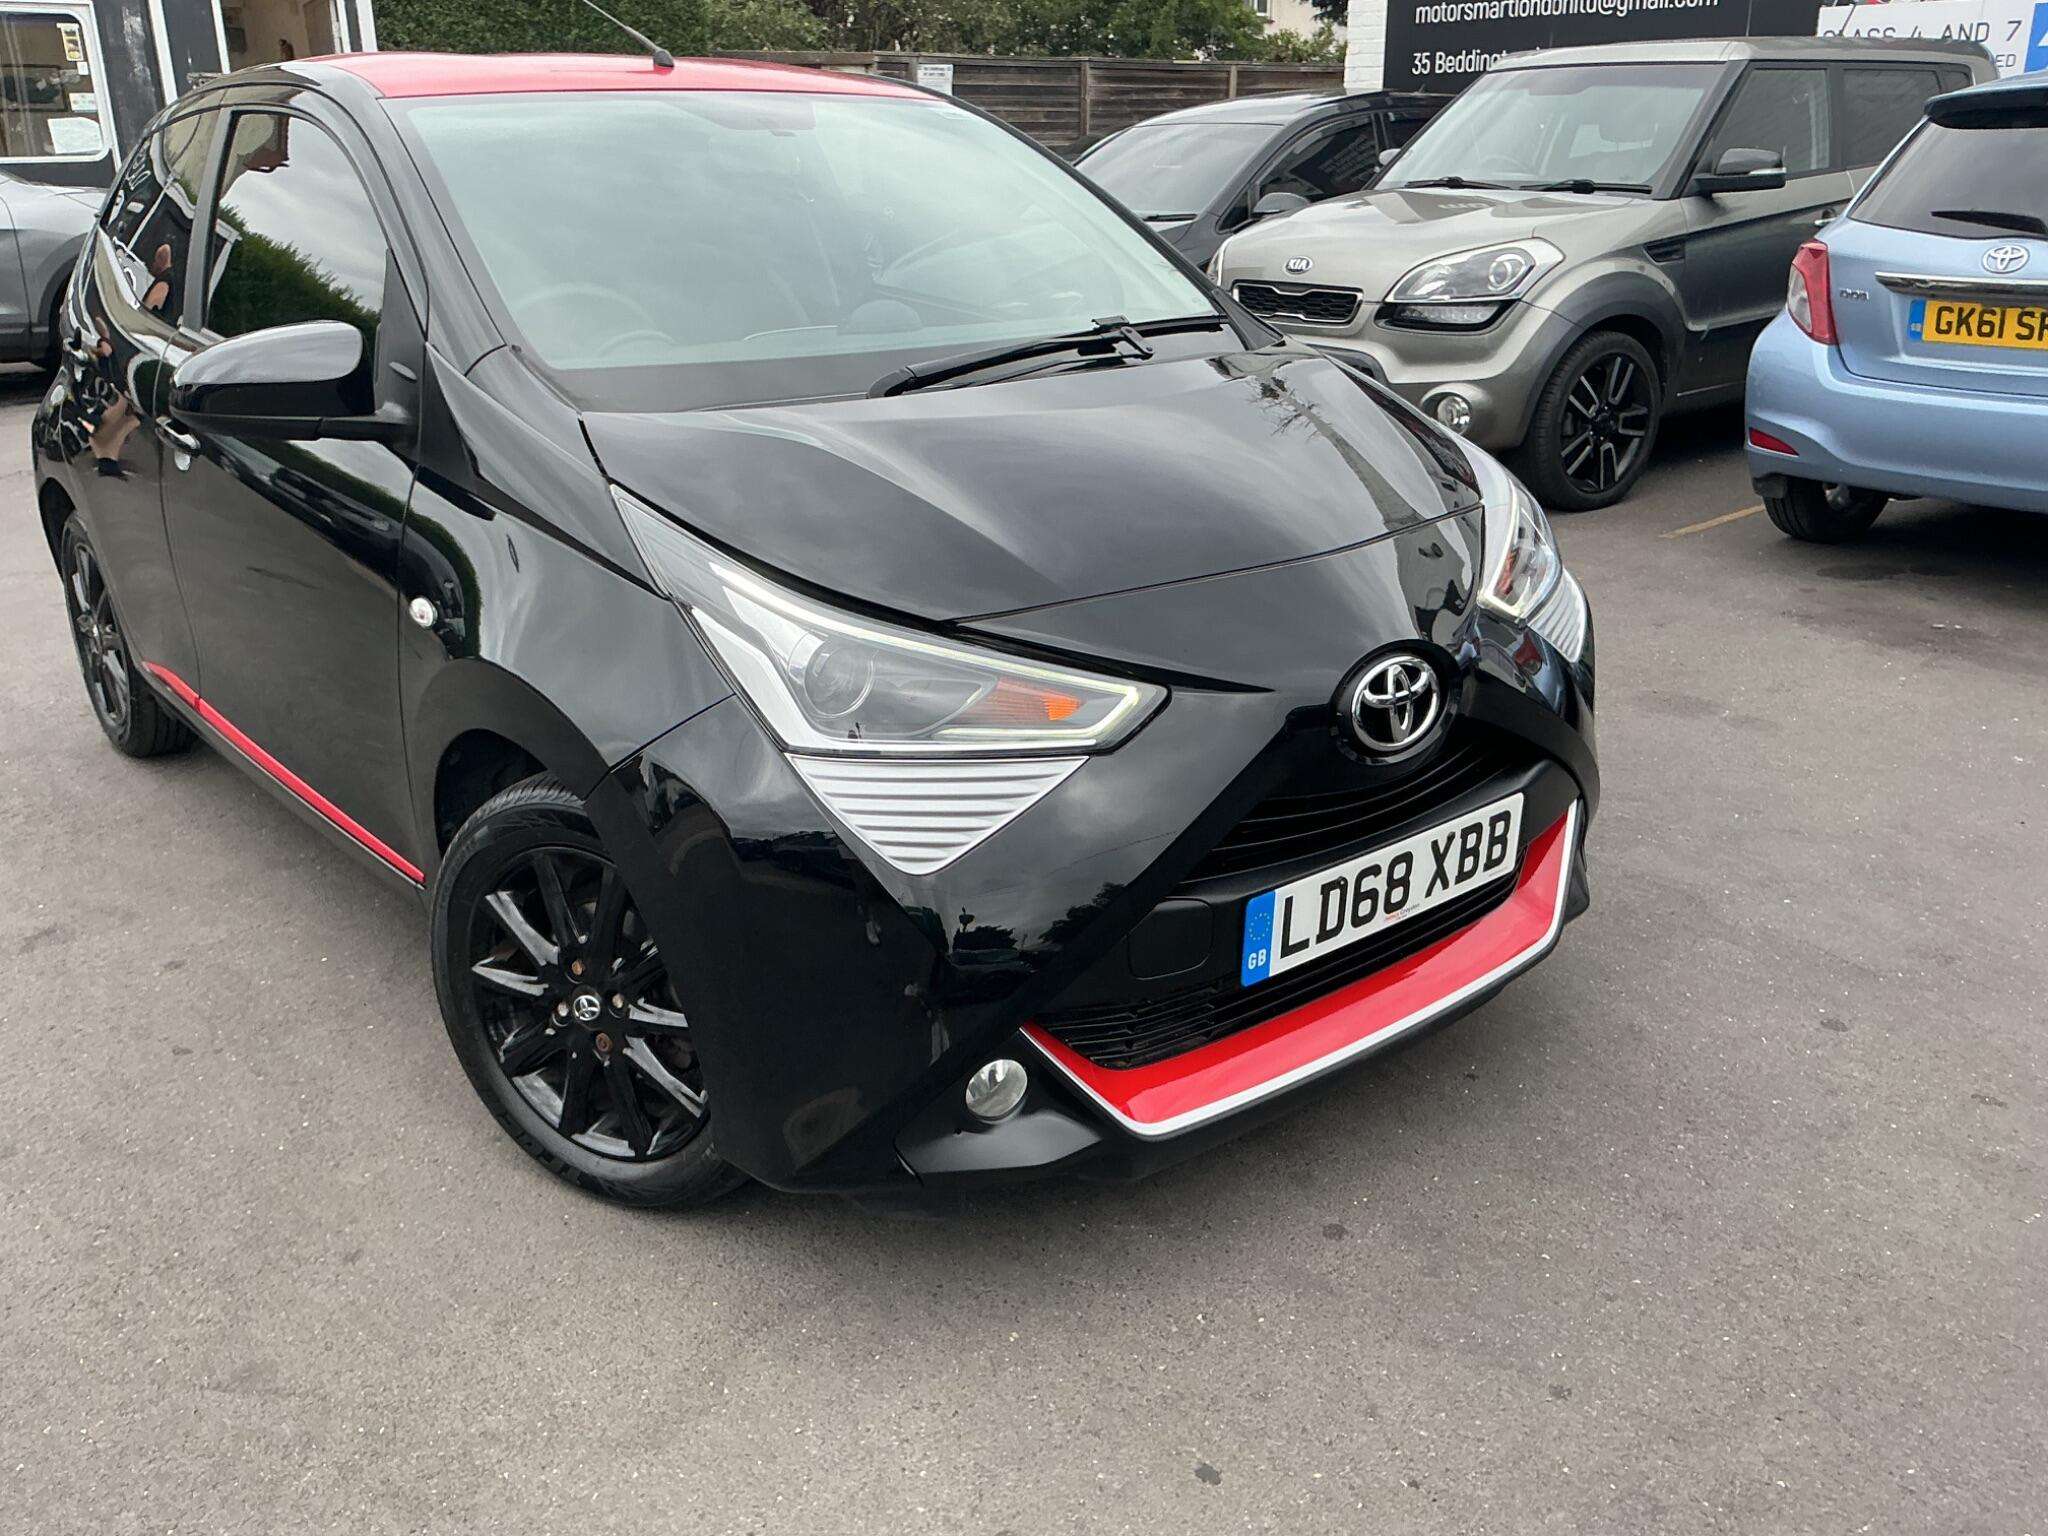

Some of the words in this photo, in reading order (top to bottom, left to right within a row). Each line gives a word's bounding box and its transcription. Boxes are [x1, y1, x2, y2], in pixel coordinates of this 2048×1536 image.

[1941, 22, 1990, 42] AND
[2006, 20, 2022, 41] 7
[1411, 52, 1431, 75] 35
[1434, 49, 1507, 74] Beddin
[1935, 305, 2007, 339] GK61
[1280, 850, 1413, 959] LD68
[1424, 810, 1511, 898] XBB
[1248, 948, 1267, 970] GB
